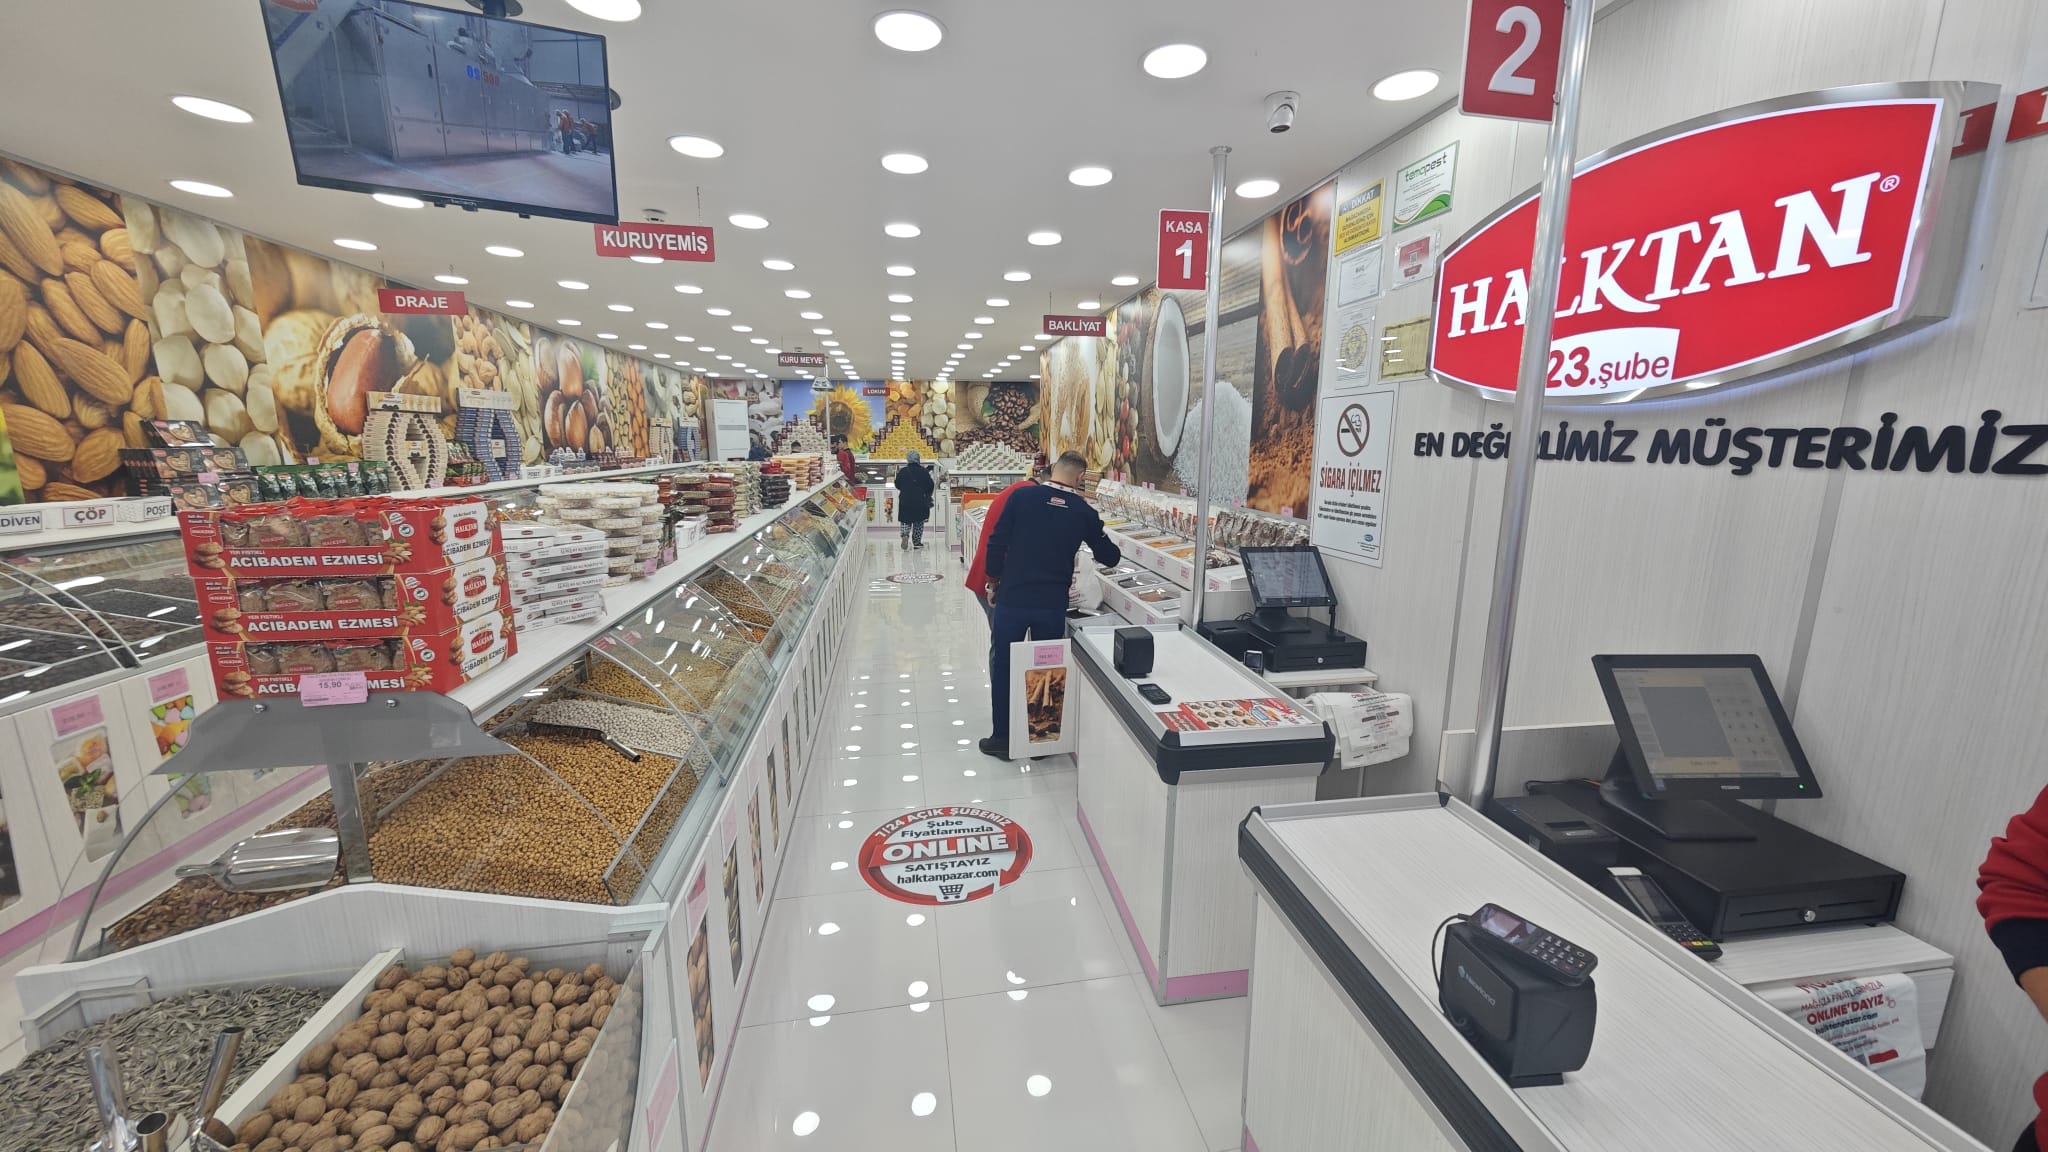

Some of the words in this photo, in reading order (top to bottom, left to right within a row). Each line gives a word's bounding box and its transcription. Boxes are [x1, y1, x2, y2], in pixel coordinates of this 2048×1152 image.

[1488, 5, 1541, 96] 2
[1166, 221, 1203, 234] KASA
[603, 230, 707, 255] KURUYEMİŞ
[1175, 239, 1192, 279] 1
[395, 295, 449, 309] DRAJE
[1049, 319, 1101, 331] BAKLİYAT
[1414, 432, 1444, 457] EN
[1451, 420, 1639, 462] DEĞLİMİZ
[1646, 410, 2048, 476] MÜŞTERİMİZ
[1320, 461, 1346, 489] SİGARA
[1348, 461, 1382, 498] İÇİLMEZ
[74, 507, 106, 523] ÇÖP
[146, 504, 170, 518] POŞET
[230, 555, 317, 568] ACIBADEM
[321, 552, 384, 566] EZMESİ
[247, 618, 333, 632] ACIBADEM
[337, 616, 399, 630] EZMESİ
[258, 683, 301, 695] ACIB
[319, 681, 341, 689] 15,90
[906, 808, 944, 823] AÇIK
[901, 826, 994, 838] Fiyatlarımızla
[927, 820, 963, 829] Şube
[883, 834, 1009, 861] ONLINE
[905, 858, 991, 872] SATIŞTAYIZ
[897, 869, 999, 884] halktanpazar.com
[1807, 994, 1884, 1025] ONLINE'DAYIZ
